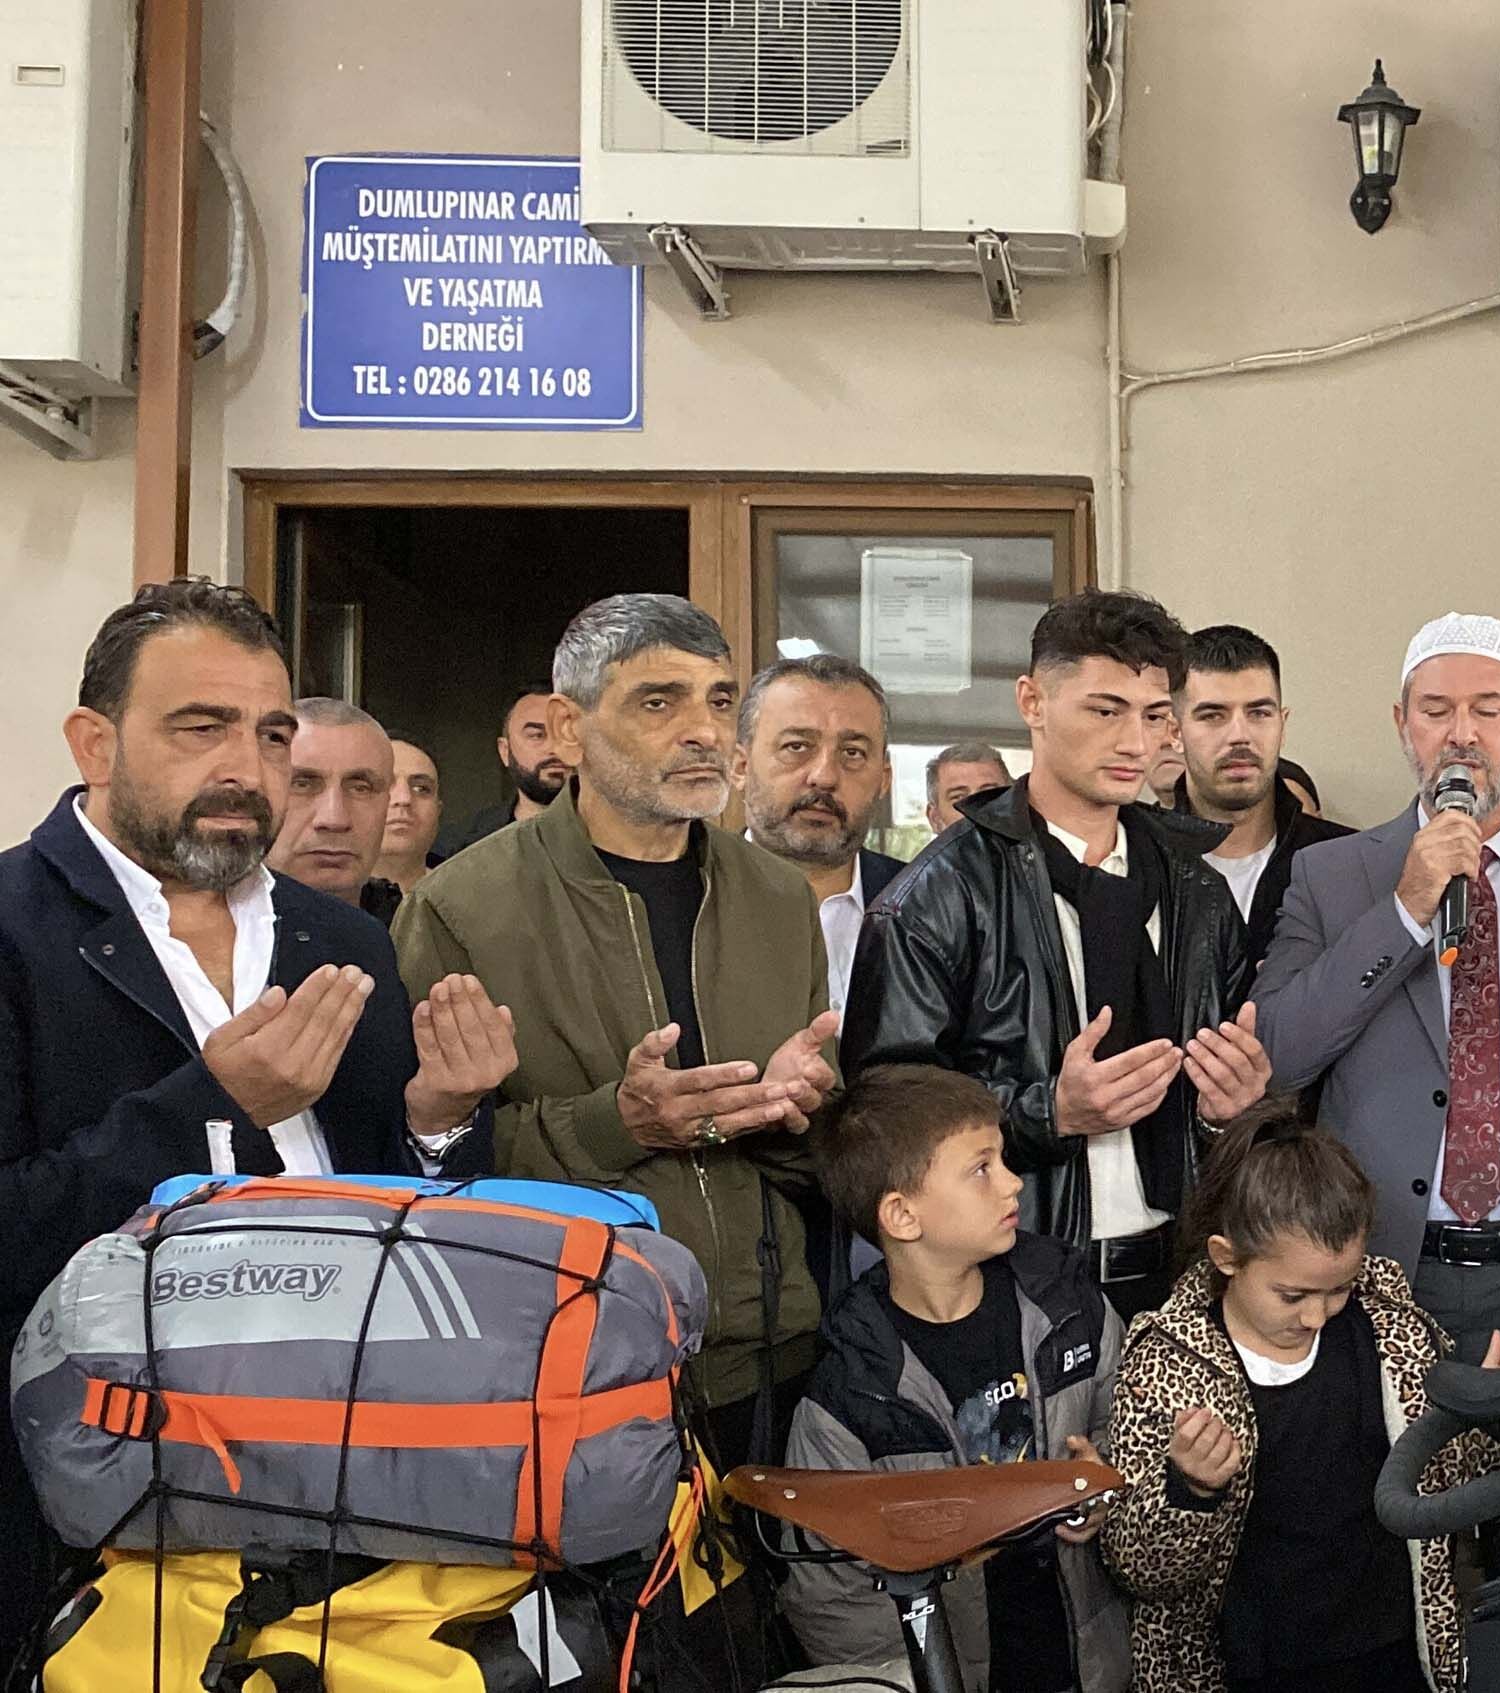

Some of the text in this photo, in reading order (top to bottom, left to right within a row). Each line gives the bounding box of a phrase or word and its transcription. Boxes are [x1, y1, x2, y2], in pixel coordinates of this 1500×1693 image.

[358, 189, 515, 220] DUMLUPINAR
[322, 225, 613, 270] MÜŞTEMİLATINI YAPTIRM
[403, 278, 543, 315] VE YAŞATMA
[422, 315, 524, 352] DERNEĞİ
[353, 365, 391, 394] TEL
[413, 366, 471, 395] 0286
[478, 367, 520, 396] 214
[529, 368, 555, 396] 16
[563, 368, 591, 397] 08
[151, 1259, 342, 1302] Bestway
